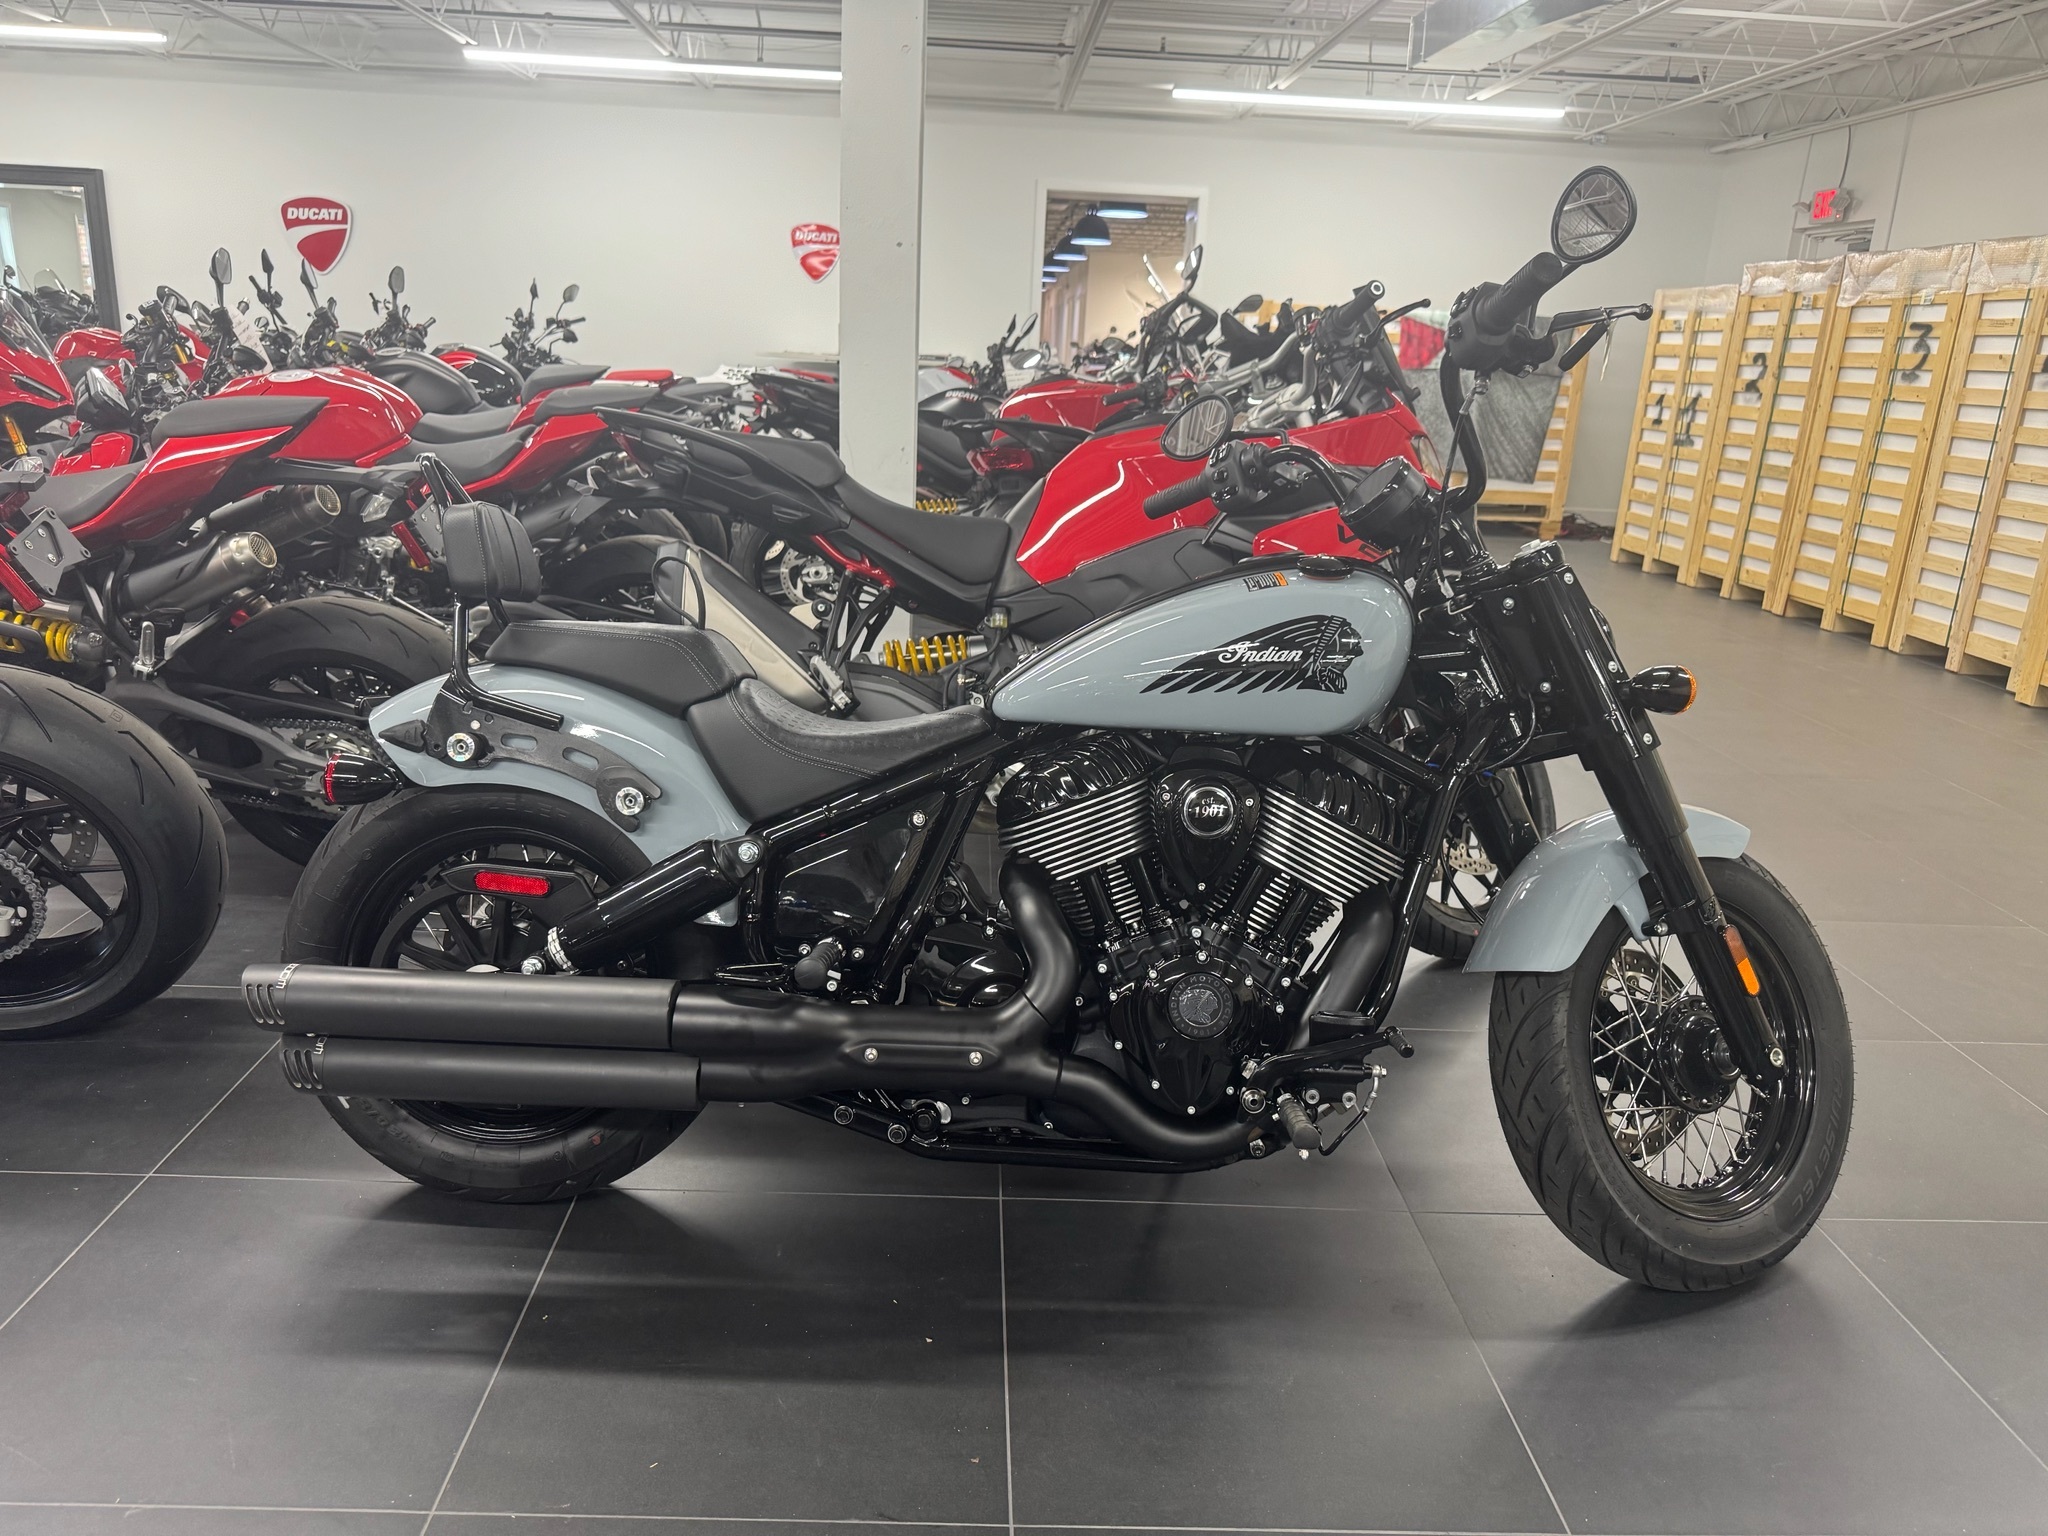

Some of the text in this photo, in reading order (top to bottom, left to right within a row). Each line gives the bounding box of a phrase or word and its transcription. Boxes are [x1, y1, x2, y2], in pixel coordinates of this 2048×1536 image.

[287, 207, 343, 221] DUCATI
[795, 229, 838, 243] DUCATI
[1901, 322, 1934, 383] 3
[1744, 352, 1768, 401] 2
[944, 390, 979, 402] DUCATI
[1217, 641, 1303, 664] Indian
[1194, 804, 1224, 818] 1901
[1189, 975, 1232, 1026] MOTORCYCLE
